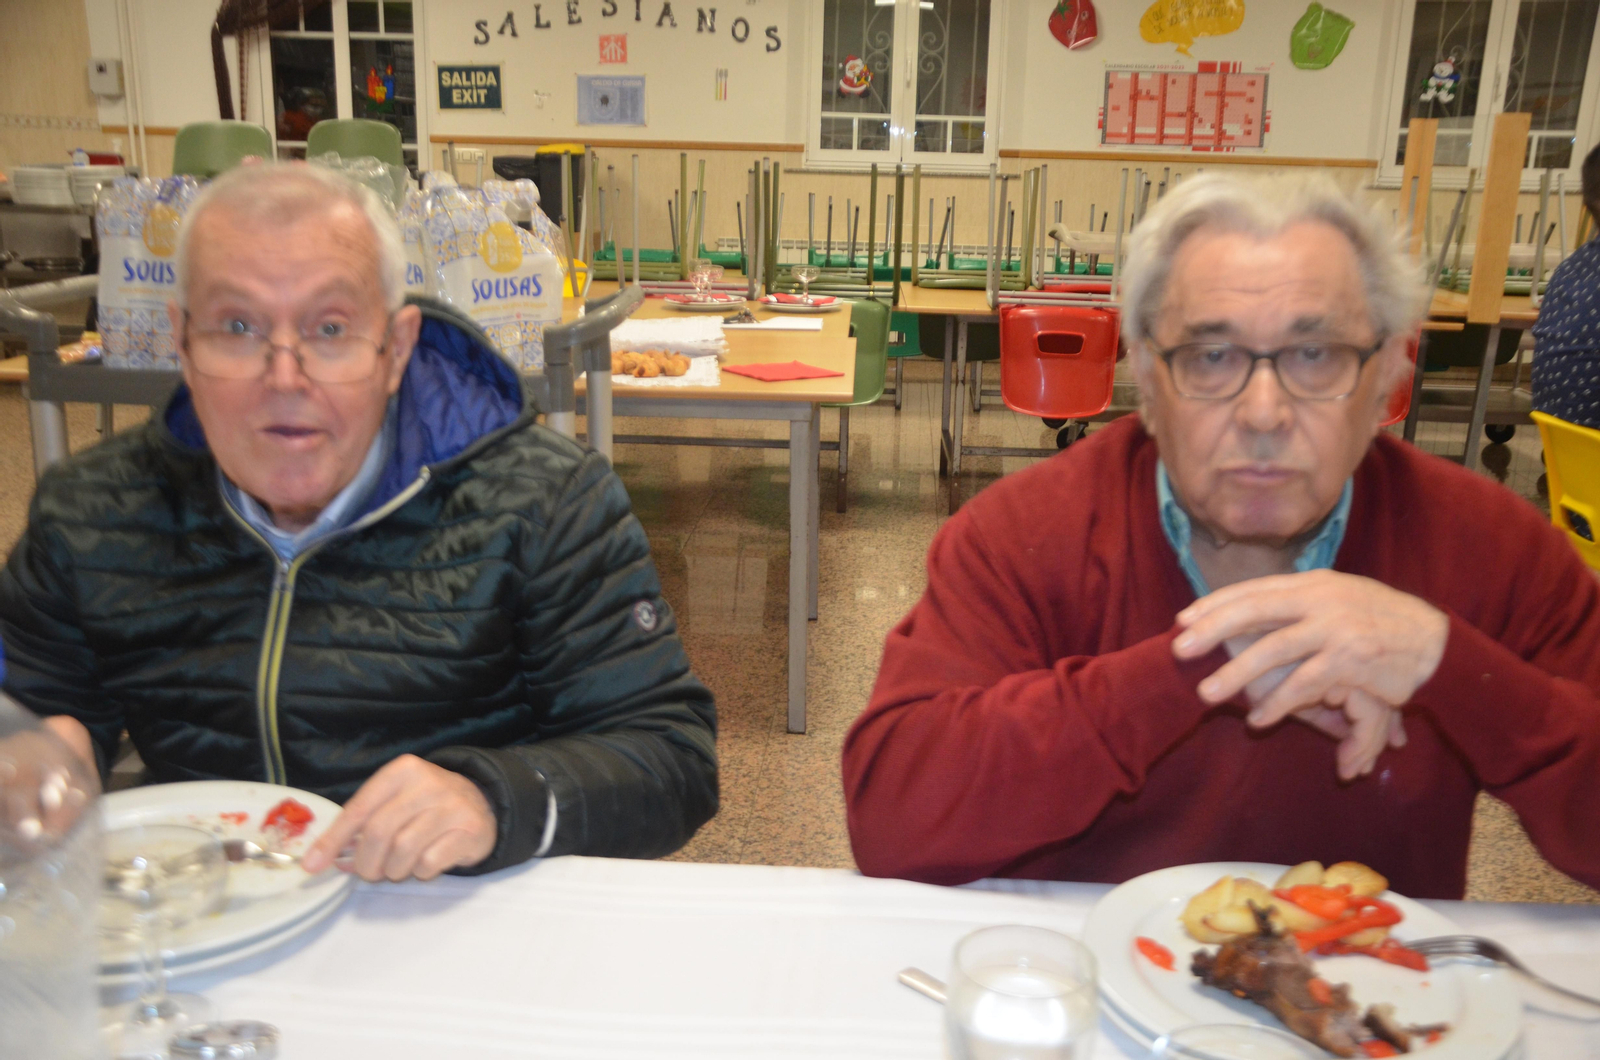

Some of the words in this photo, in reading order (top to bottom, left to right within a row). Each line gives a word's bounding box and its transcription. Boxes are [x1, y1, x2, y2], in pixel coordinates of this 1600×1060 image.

[474, 0, 781, 52] SALESIANOS
[441, 71, 497, 87] SALIDA
[452, 88, 487, 104] EXIT
[123, 257, 177, 284] SOUS
[472, 273, 542, 303] SOUSAS
